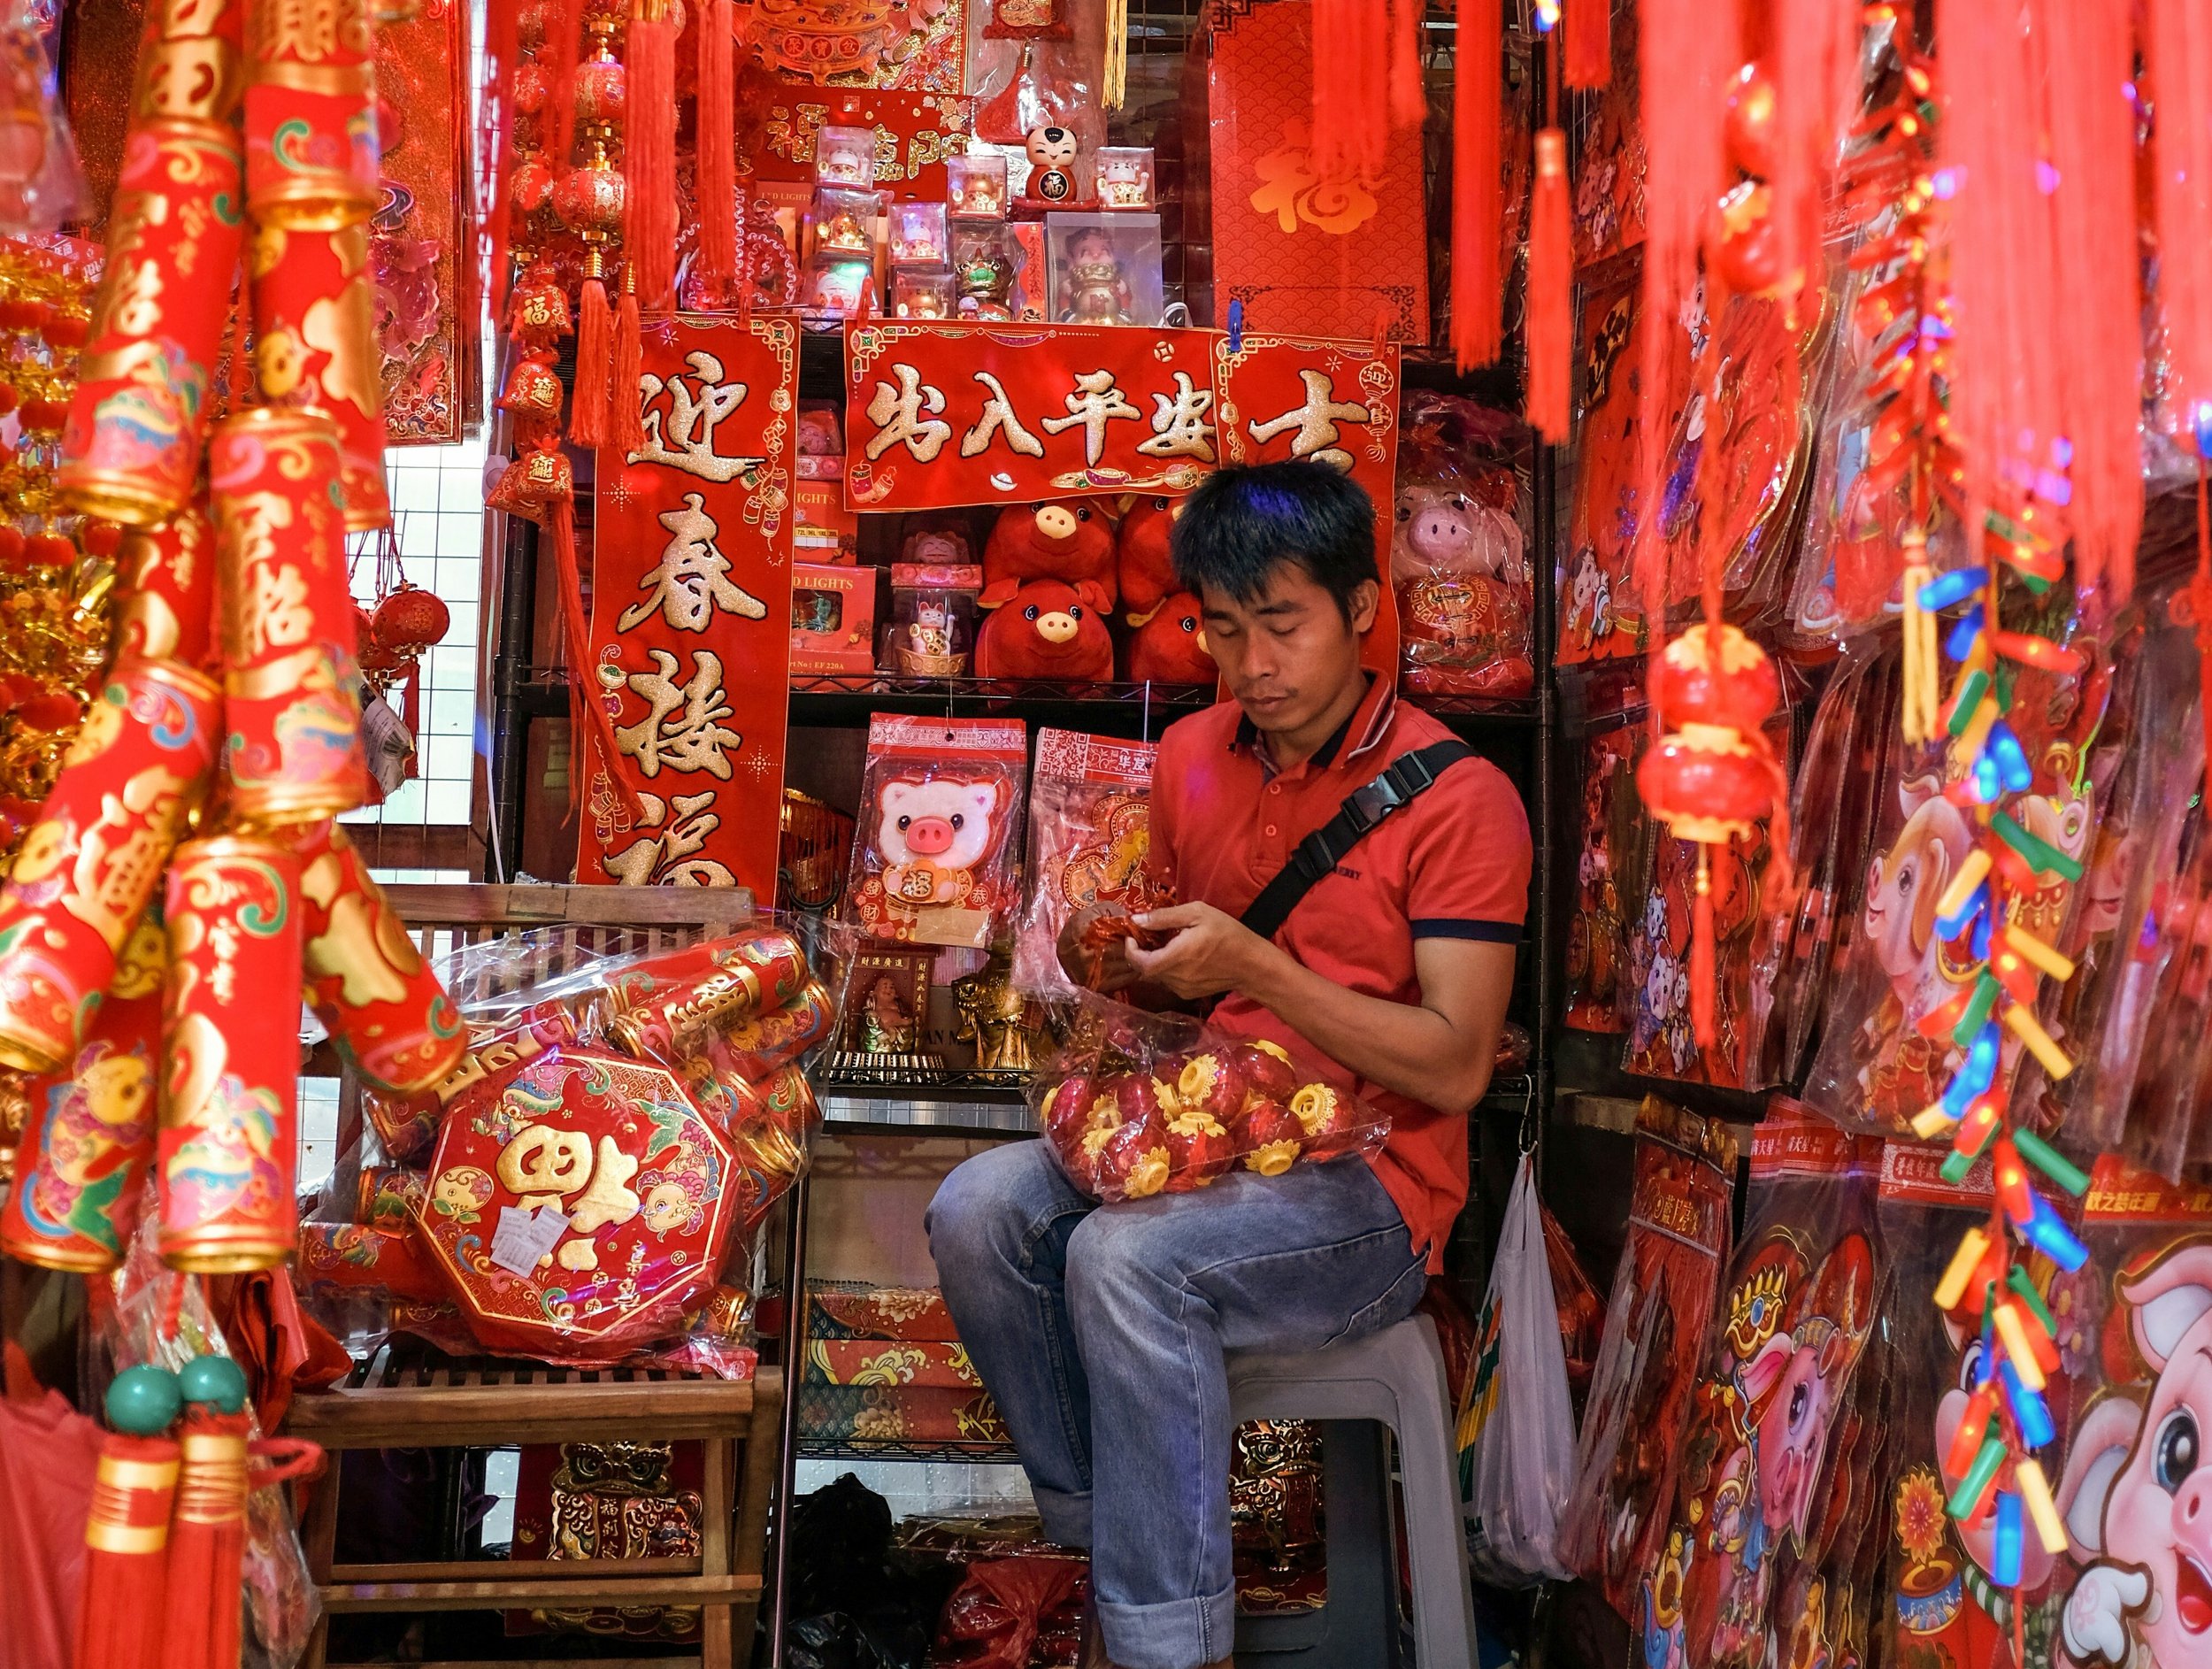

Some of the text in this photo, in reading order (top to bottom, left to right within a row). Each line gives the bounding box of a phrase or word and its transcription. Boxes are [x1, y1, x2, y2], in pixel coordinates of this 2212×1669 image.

[1046, 173, 1064, 195] 福
[523, 295, 549, 324] 福
[865, 363, 1217, 467] 出入平安
[796, 493, 836, 504] IGHTS
[804, 577, 854, 590] LIGHTS
[603, 350, 767, 887] 迎春接福
[902, 869, 932, 897] 福
[972, 888, 988, 904] 恭
[861, 957, 904, 968] 財源廣進
